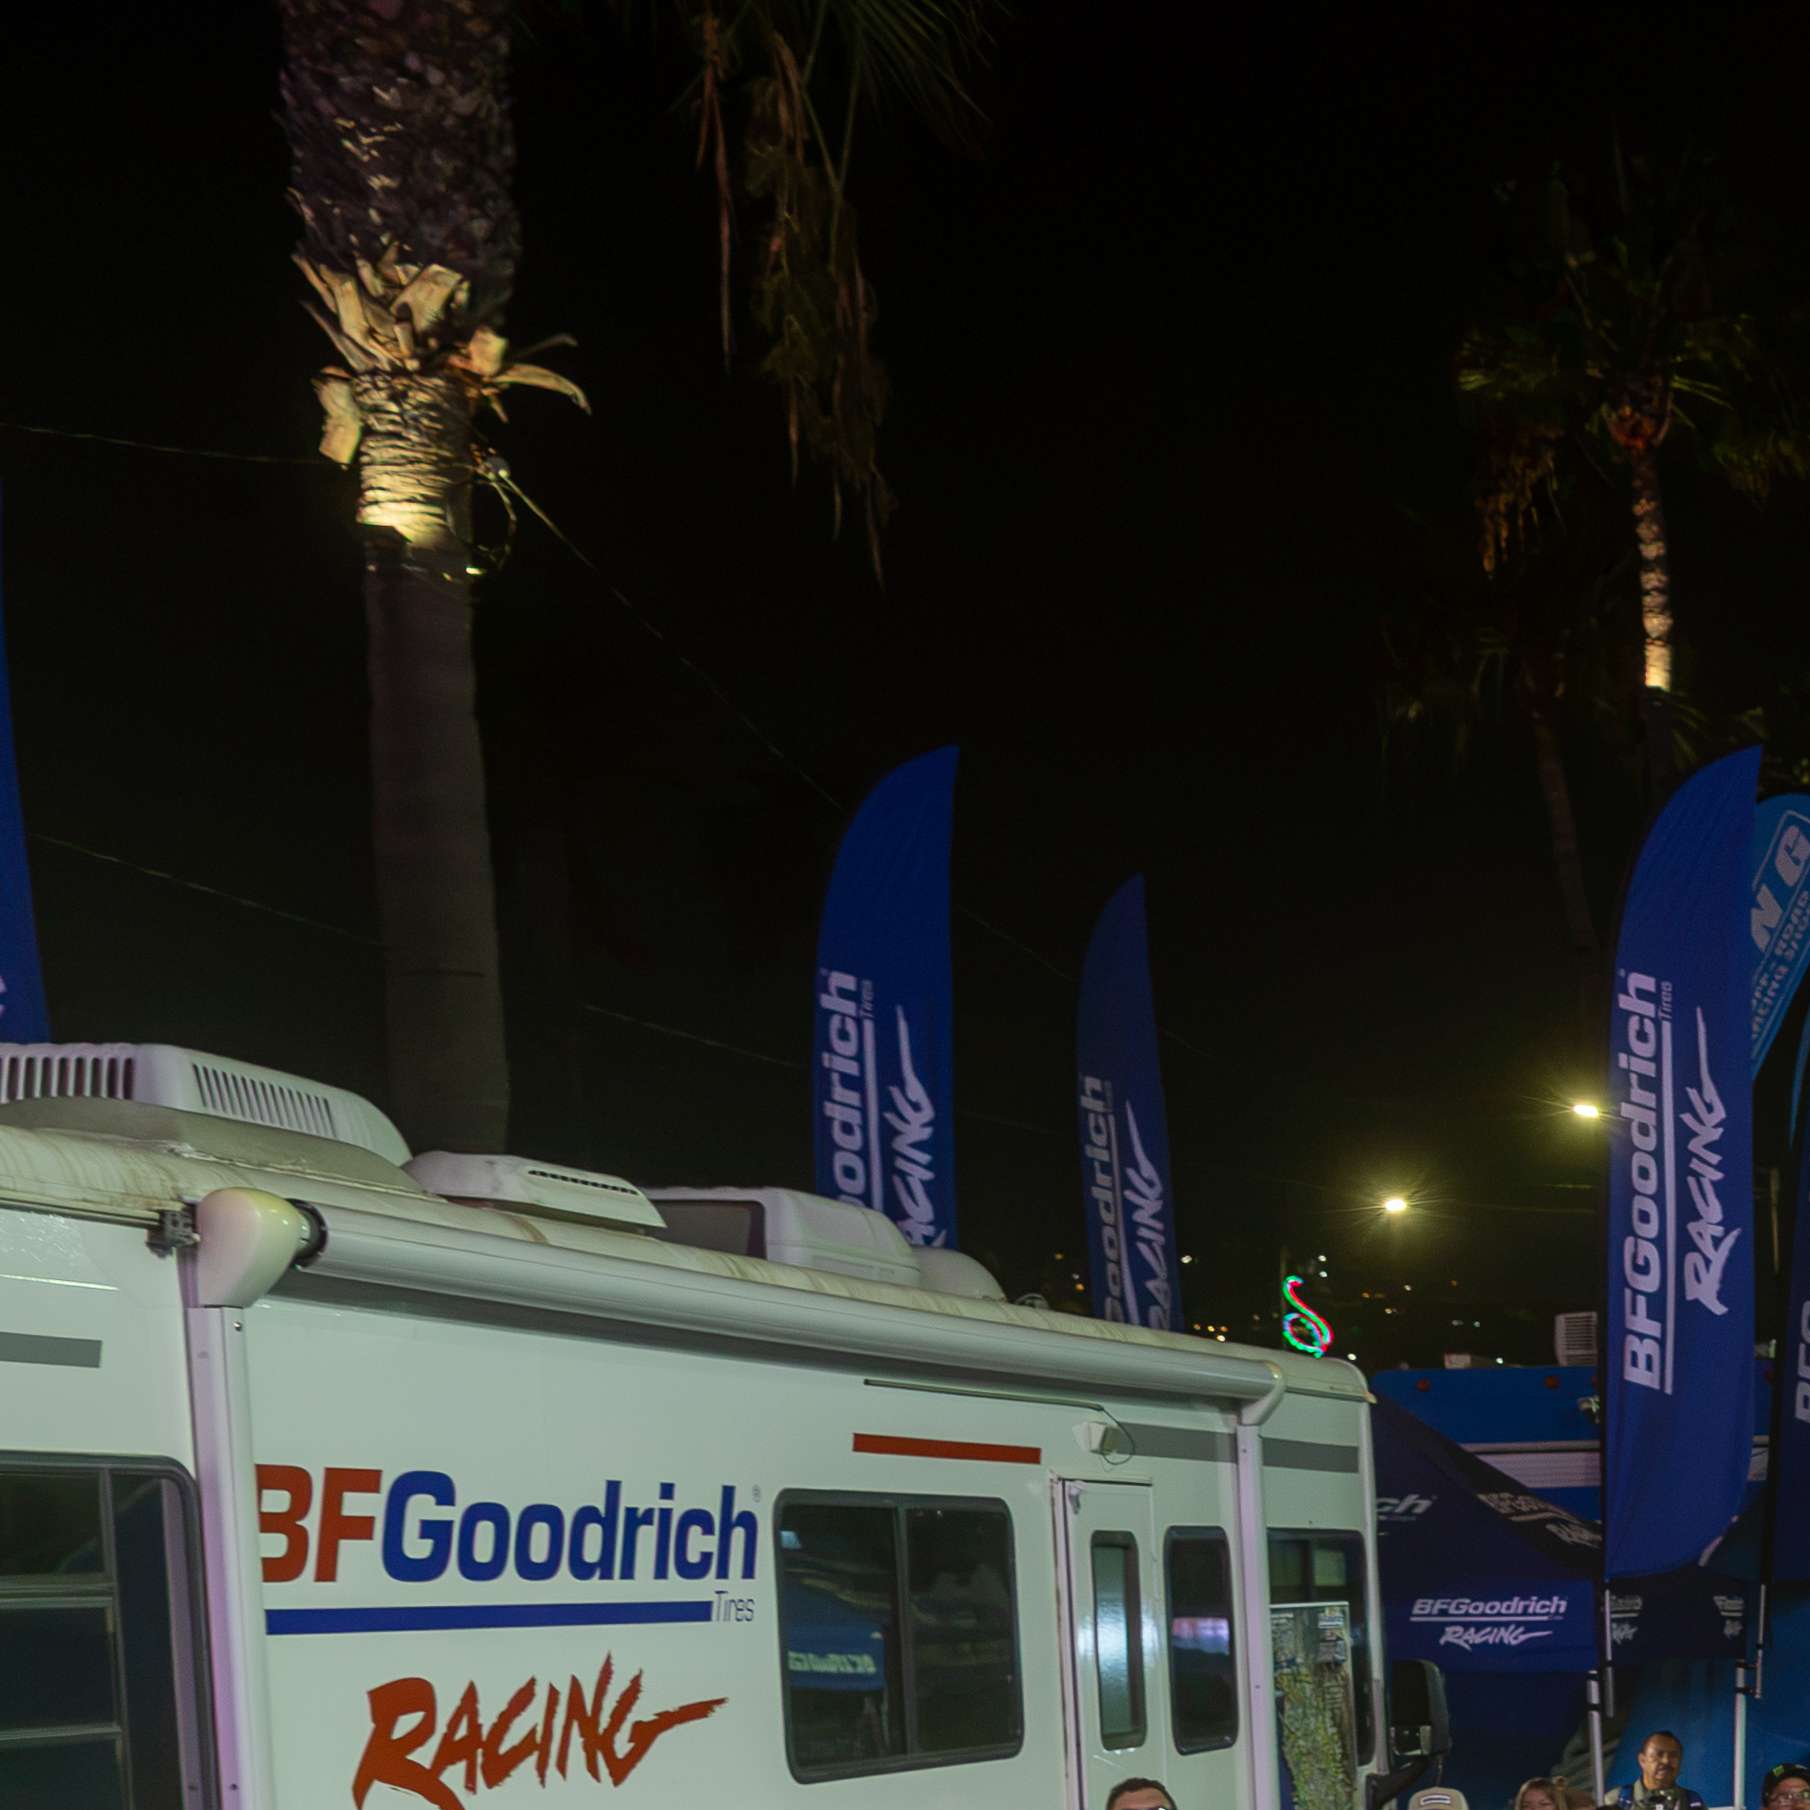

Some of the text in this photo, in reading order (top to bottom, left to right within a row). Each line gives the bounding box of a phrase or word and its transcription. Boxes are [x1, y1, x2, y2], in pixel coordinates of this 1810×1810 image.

[1618, 970, 1662, 1391] BFGoodrich
[1684, 1005, 1742, 1316] RACING
[254, 1463, 758, 1583] BFGoodrich
[715, 1590, 755, 1622] Tires
[1411, 1596, 1568, 1616] BFGoodrich
[1439, 1623, 1553, 1651] RACING
